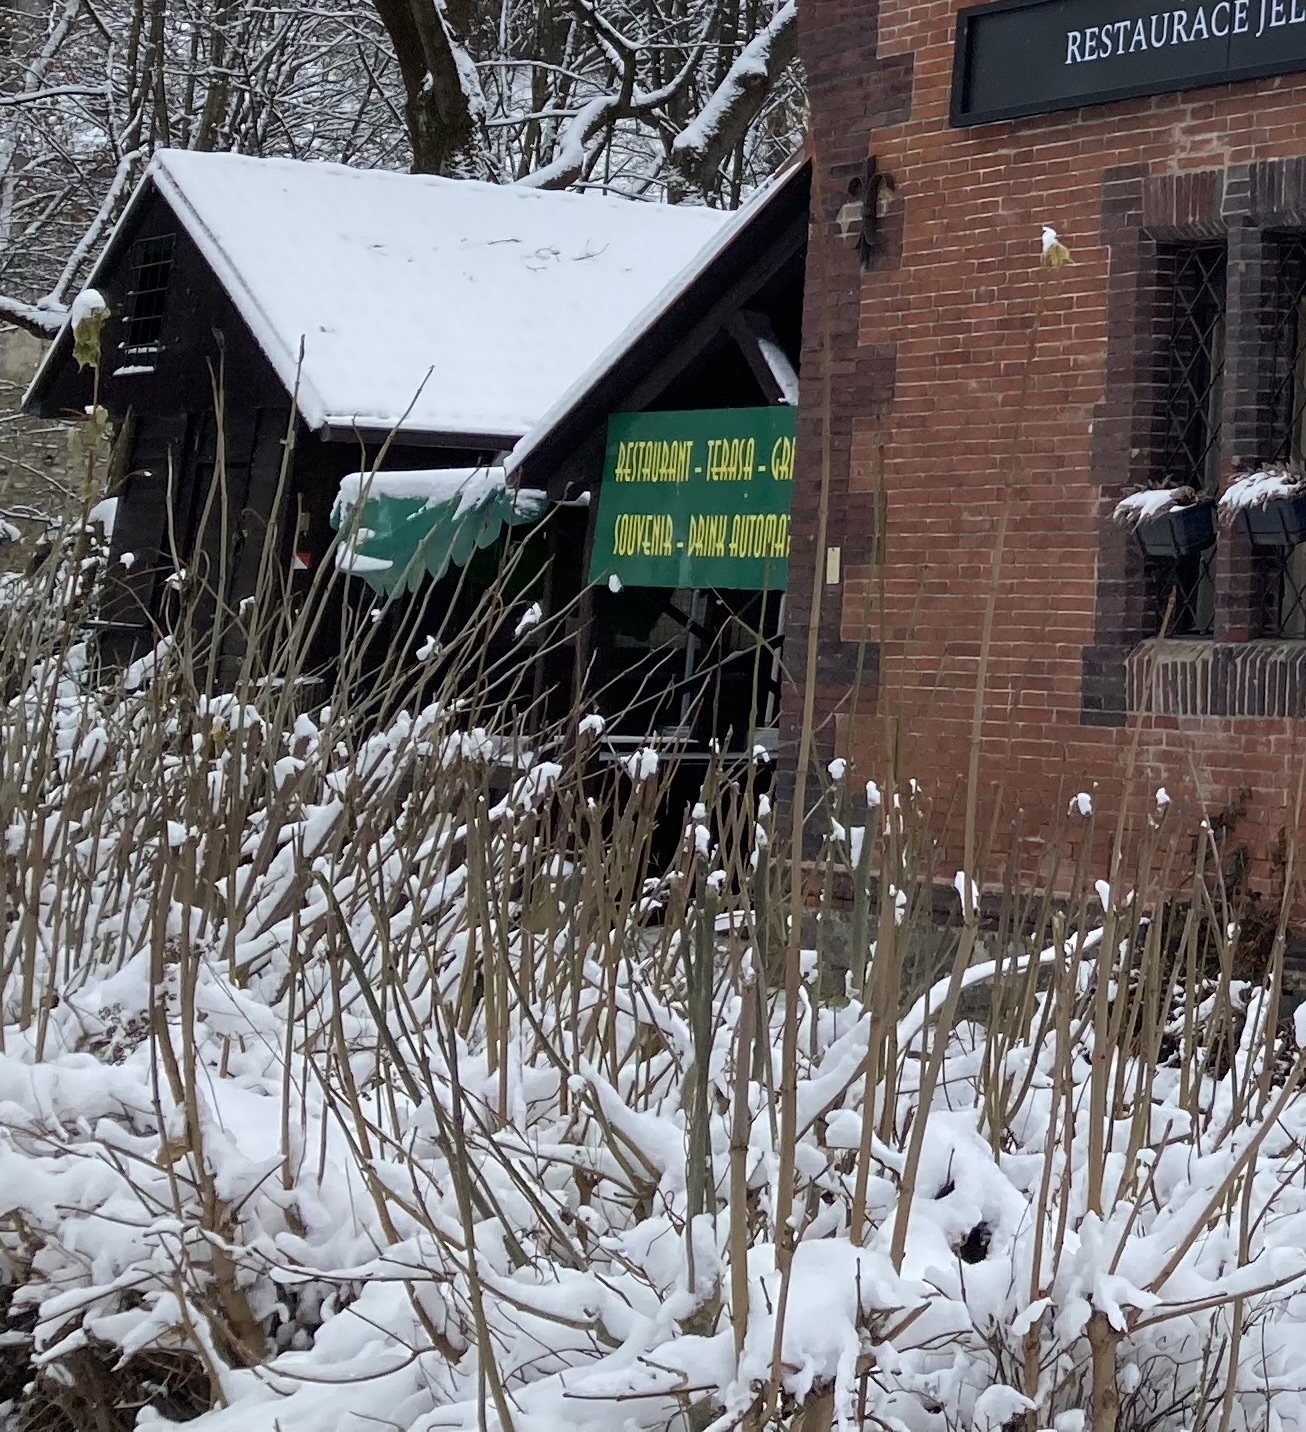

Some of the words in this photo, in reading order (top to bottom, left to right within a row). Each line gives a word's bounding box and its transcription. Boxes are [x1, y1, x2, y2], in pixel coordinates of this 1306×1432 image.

[615, 440, 694, 482] RESTAURANT
[706, 437, 755, 482] TERASA
[613, 514, 673, 556] SOUVENIR
[687, 514, 728, 558] DRINK
